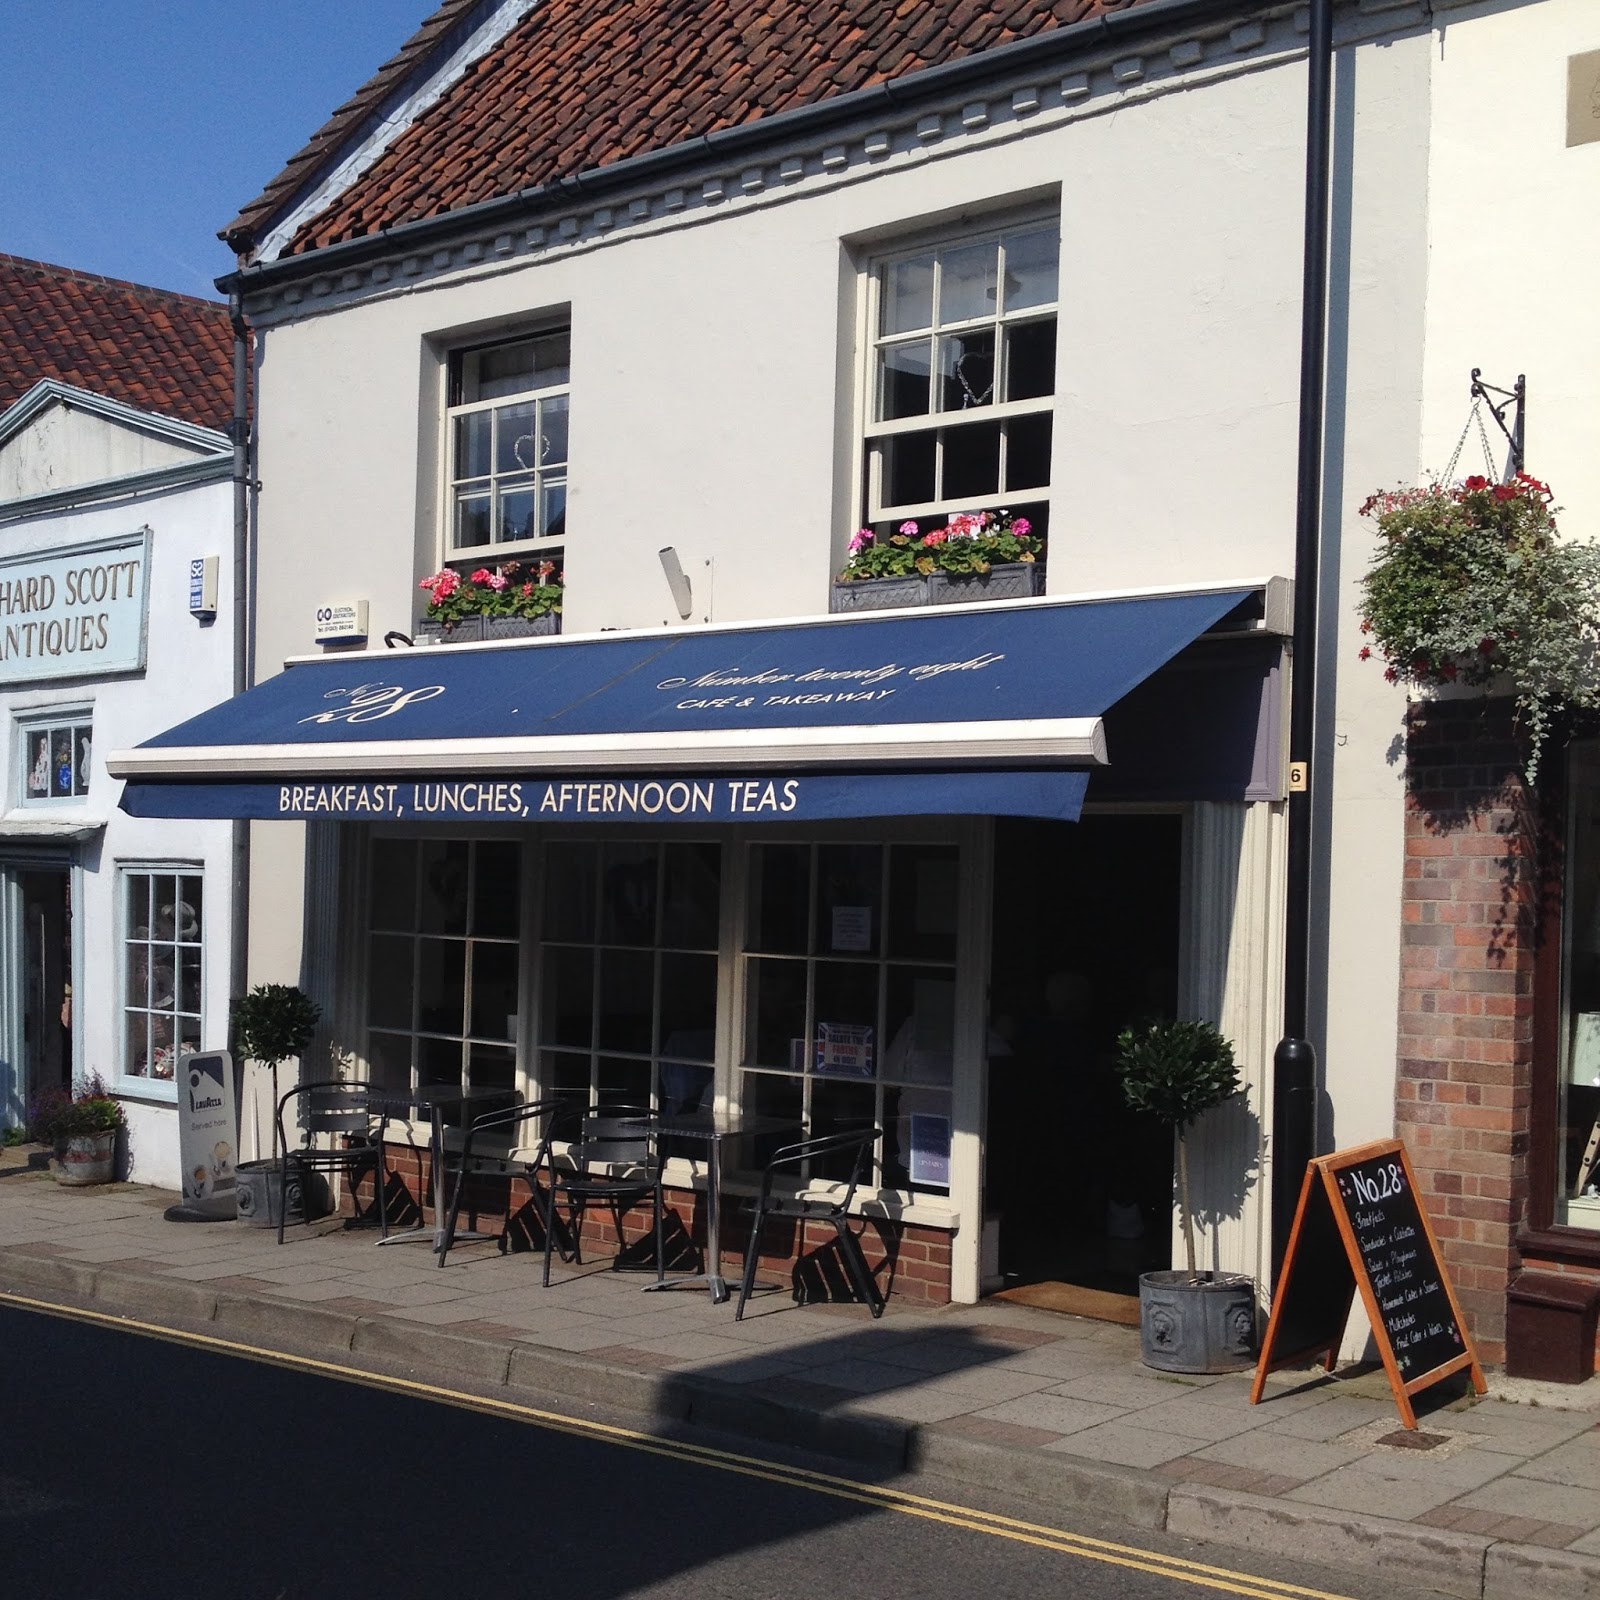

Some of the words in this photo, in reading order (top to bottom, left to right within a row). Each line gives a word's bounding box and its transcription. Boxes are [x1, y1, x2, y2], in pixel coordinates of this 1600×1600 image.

[65, 560, 141, 606] SCOTT
[0, 612, 109, 661] NTIQUES
[656, 667, 796, 690] Number
[794, 663, 907, 686] twenty
[908, 652, 1006, 682] eight
[296, 685, 446, 724] 28
[676, 695, 739, 709] CAFÉ
[735, 697, 755, 707] &
[762, 689, 897, 706] TAKEAWAY
[1291, 768, 1302, 783] 6
[279, 784, 404, 818] BREAKFAST,
[413, 782, 529, 818] LUNCHES,
[539, 781, 715, 814] AFTERNOON
[728, 779, 799, 812] TEAS
[1350, 1163, 1402, 1205] No.28
